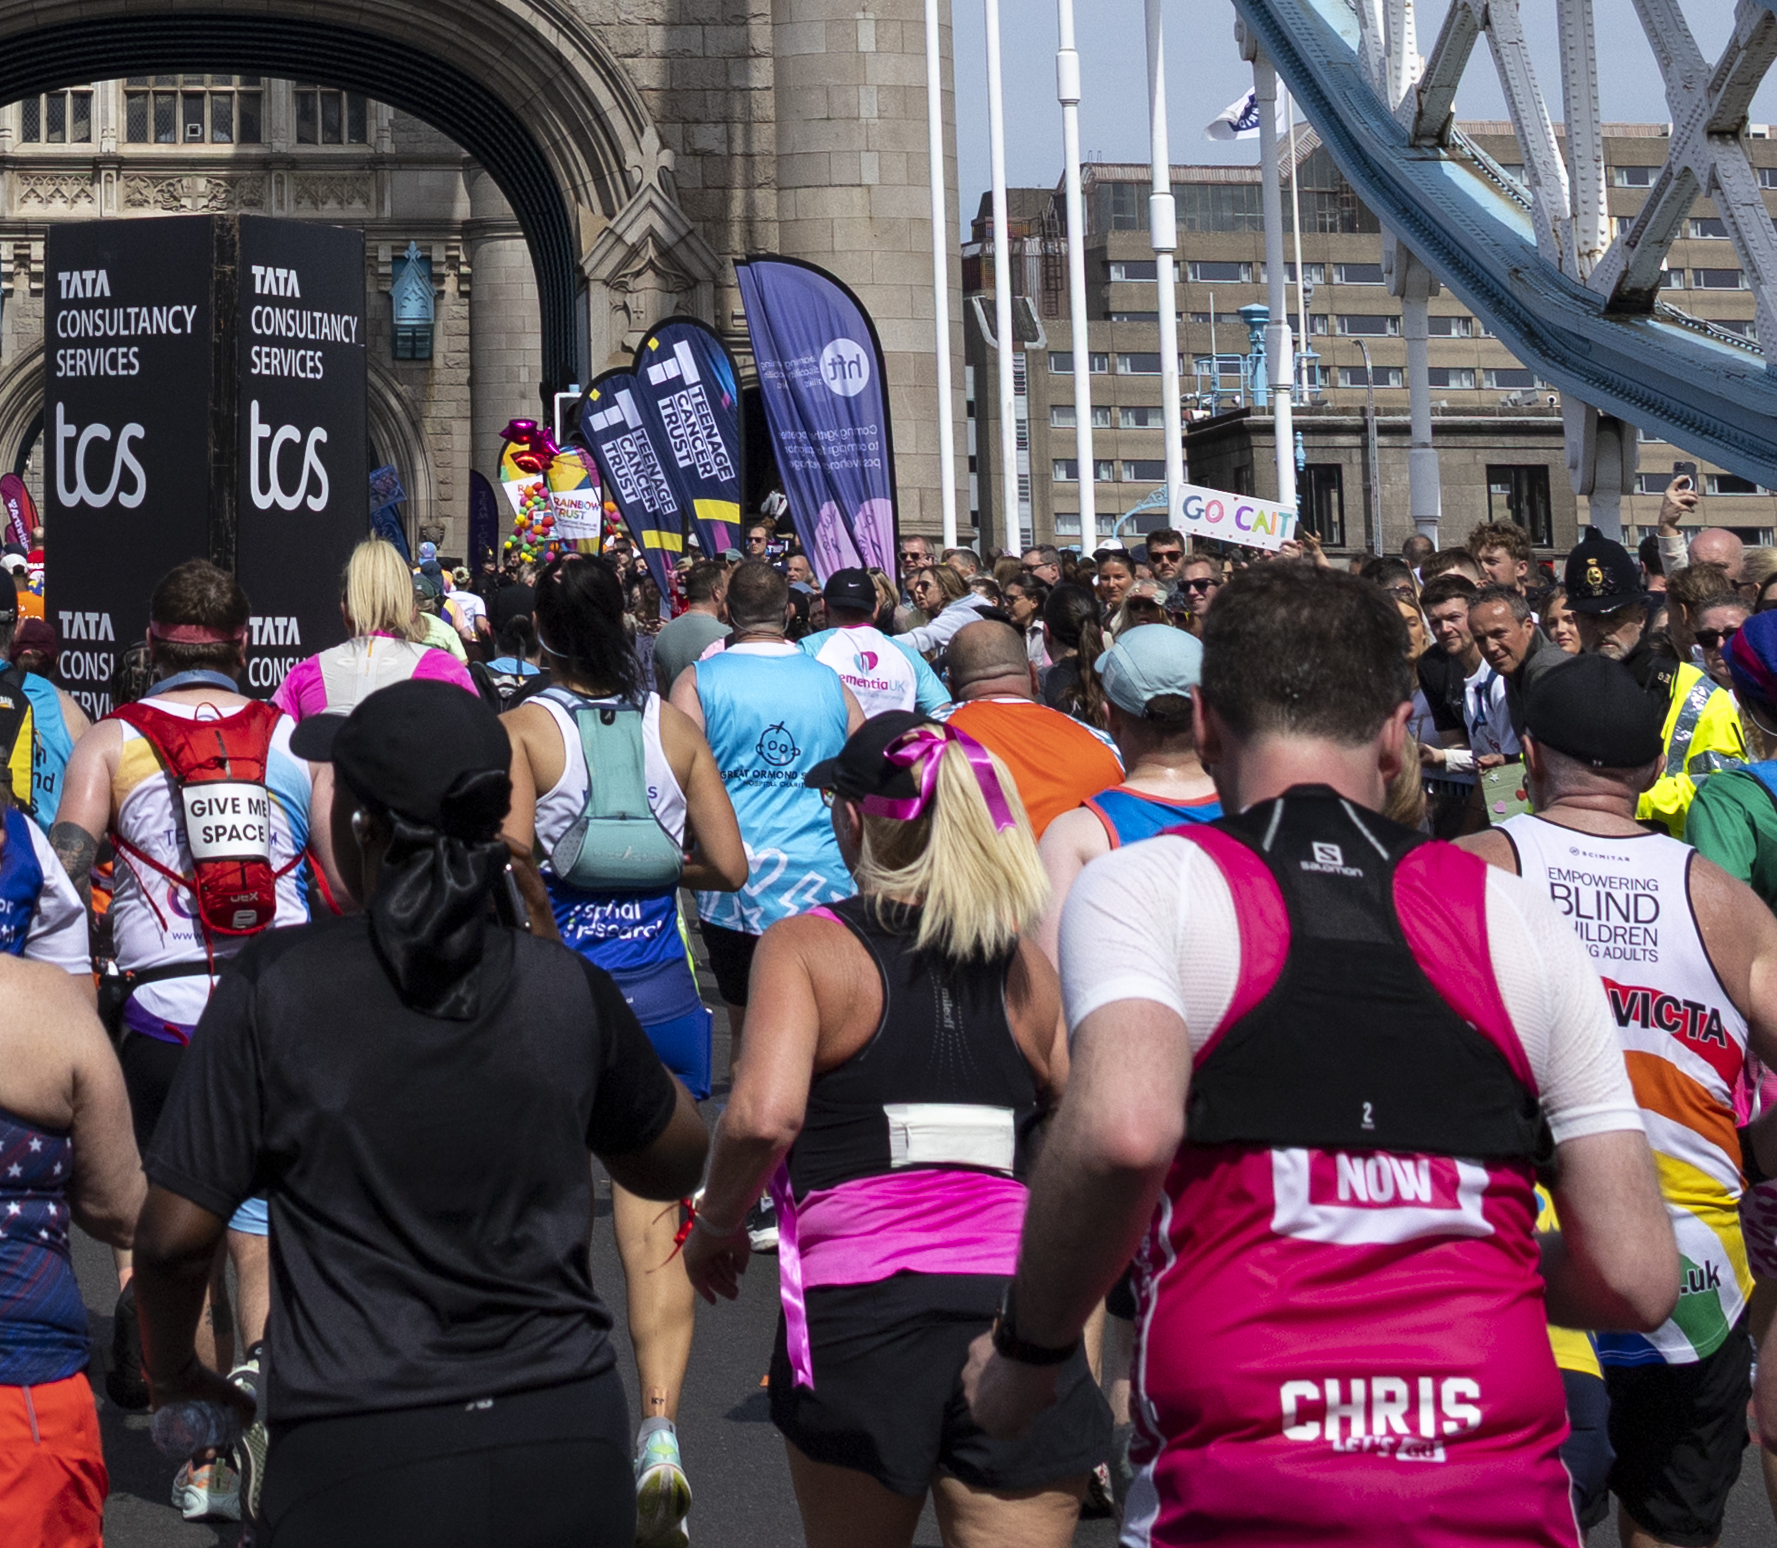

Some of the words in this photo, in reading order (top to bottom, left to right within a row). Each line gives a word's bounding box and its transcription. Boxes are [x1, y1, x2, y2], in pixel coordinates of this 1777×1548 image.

[57, 269, 111, 300] TATA
[251, 265, 301, 299] TATA
[56, 304, 198, 338] CONSULTANCY
[250, 305, 359, 344] CONSULTANCY
[56, 346, 141, 378] SERVICES
[250, 345, 324, 380] SERVICES
[660, 398, 692, 465] TRUST
[677, 393, 714, 477] CANCER
[690, 385, 734, 481] TEENAGE
[55, 401, 147, 509] tcs
[250, 399, 330, 512] tcs
[604, 442, 638, 501] TRUST
[634, 429, 675, 513] TEENAGE
[620, 437, 657, 511] CANCER
[553, 497, 600, 512] RAINBOW
[1182, 495, 1225, 524] GO
[1235, 505, 1293, 538] CAIT
[58, 610, 115, 642] TATA
[249, 616, 301, 646] TATA
[720, 769, 750, 780] GREAT
[751, 769, 798, 780] ORMOND
[779, 781, 806, 789] CHARIT
[190, 797, 241, 818] GIVE
[248, 797, 268, 818] ME
[202, 823, 265, 844] SPACE
[1582, 850, 1631, 862] SCIMITAR
[1548, 867, 1659, 892] EMPOWERING
[1550, 881, 1661, 924] BLIND
[1574, 920, 1659, 948] ILDREN
[1602, 946, 1659, 963] ADULTS
[1608, 988, 1728, 1049] VICTA
[1335, 1152, 1432, 1203] NOW
[1279, 1375, 1483, 1442] CHRIS
